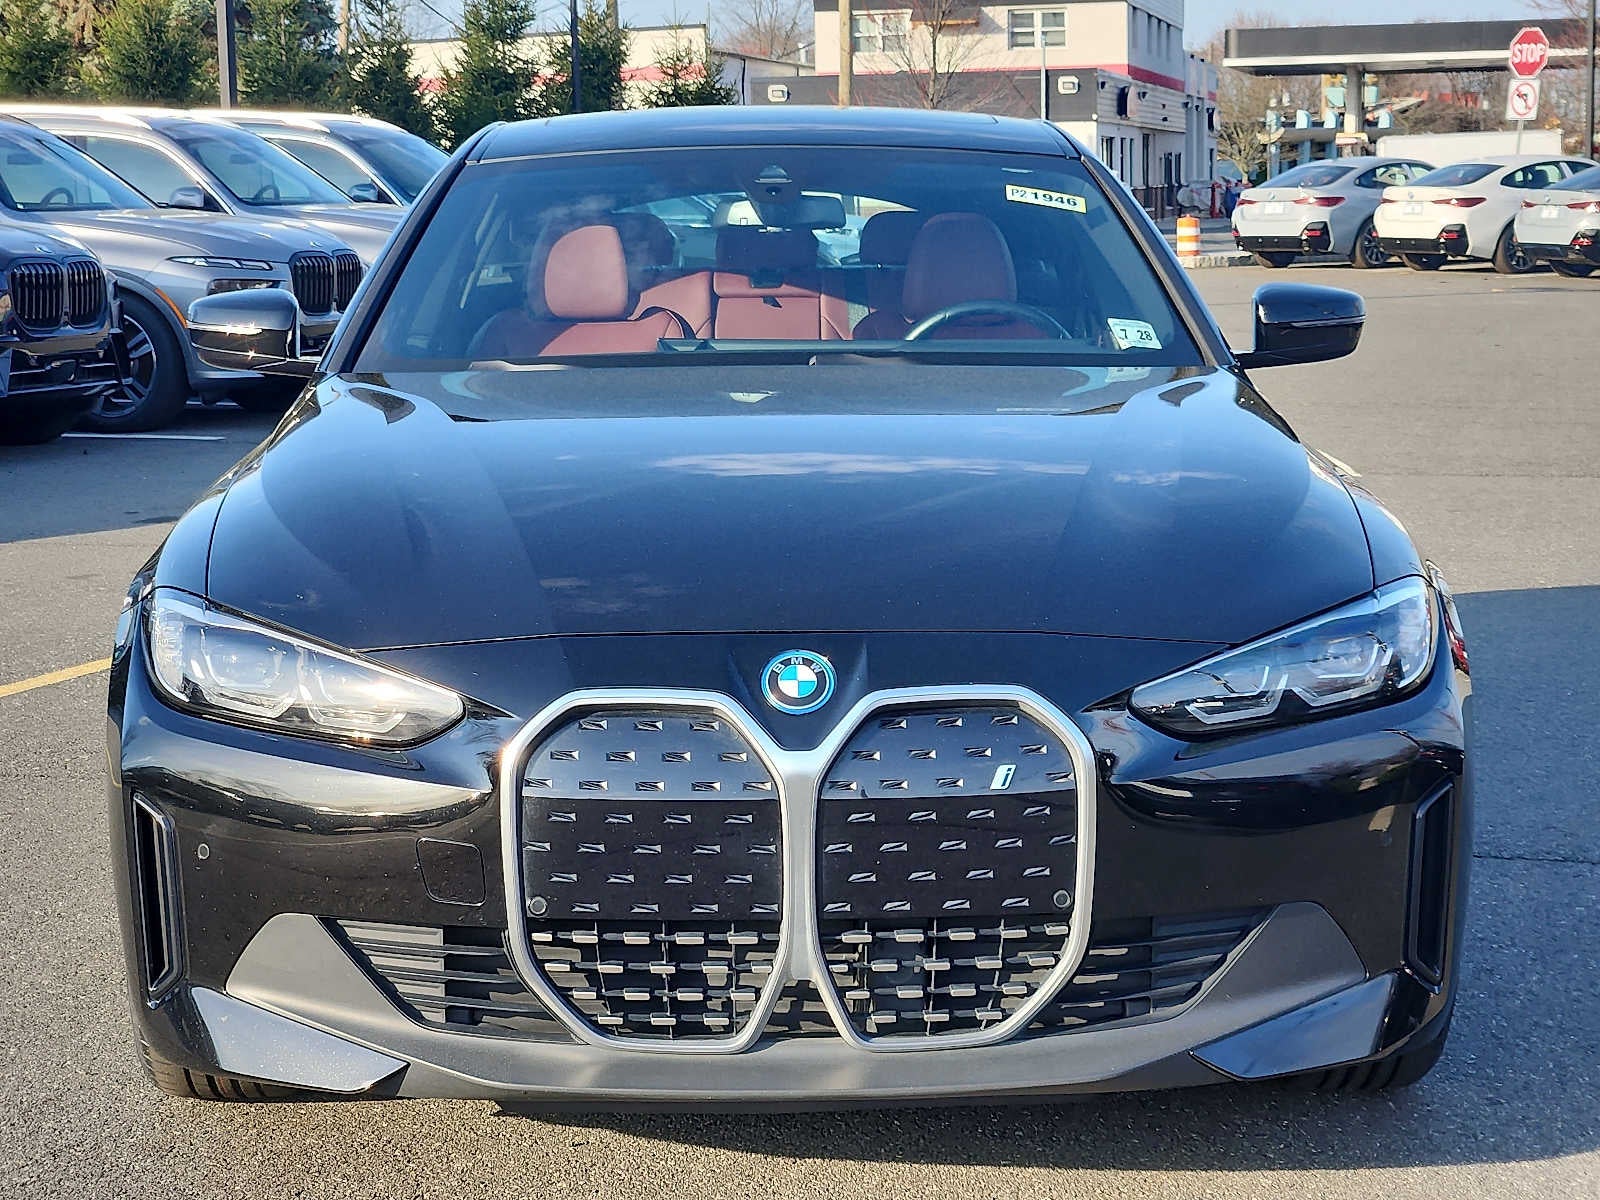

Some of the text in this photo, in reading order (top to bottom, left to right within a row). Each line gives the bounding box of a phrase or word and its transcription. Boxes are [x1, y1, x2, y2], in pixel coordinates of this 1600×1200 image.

[1512, 43, 1546, 63] STOP
[1031, 191, 1077, 207] 1946
[1120, 328, 1153, 341] 7 28
[772, 656, 823, 674] BMW
